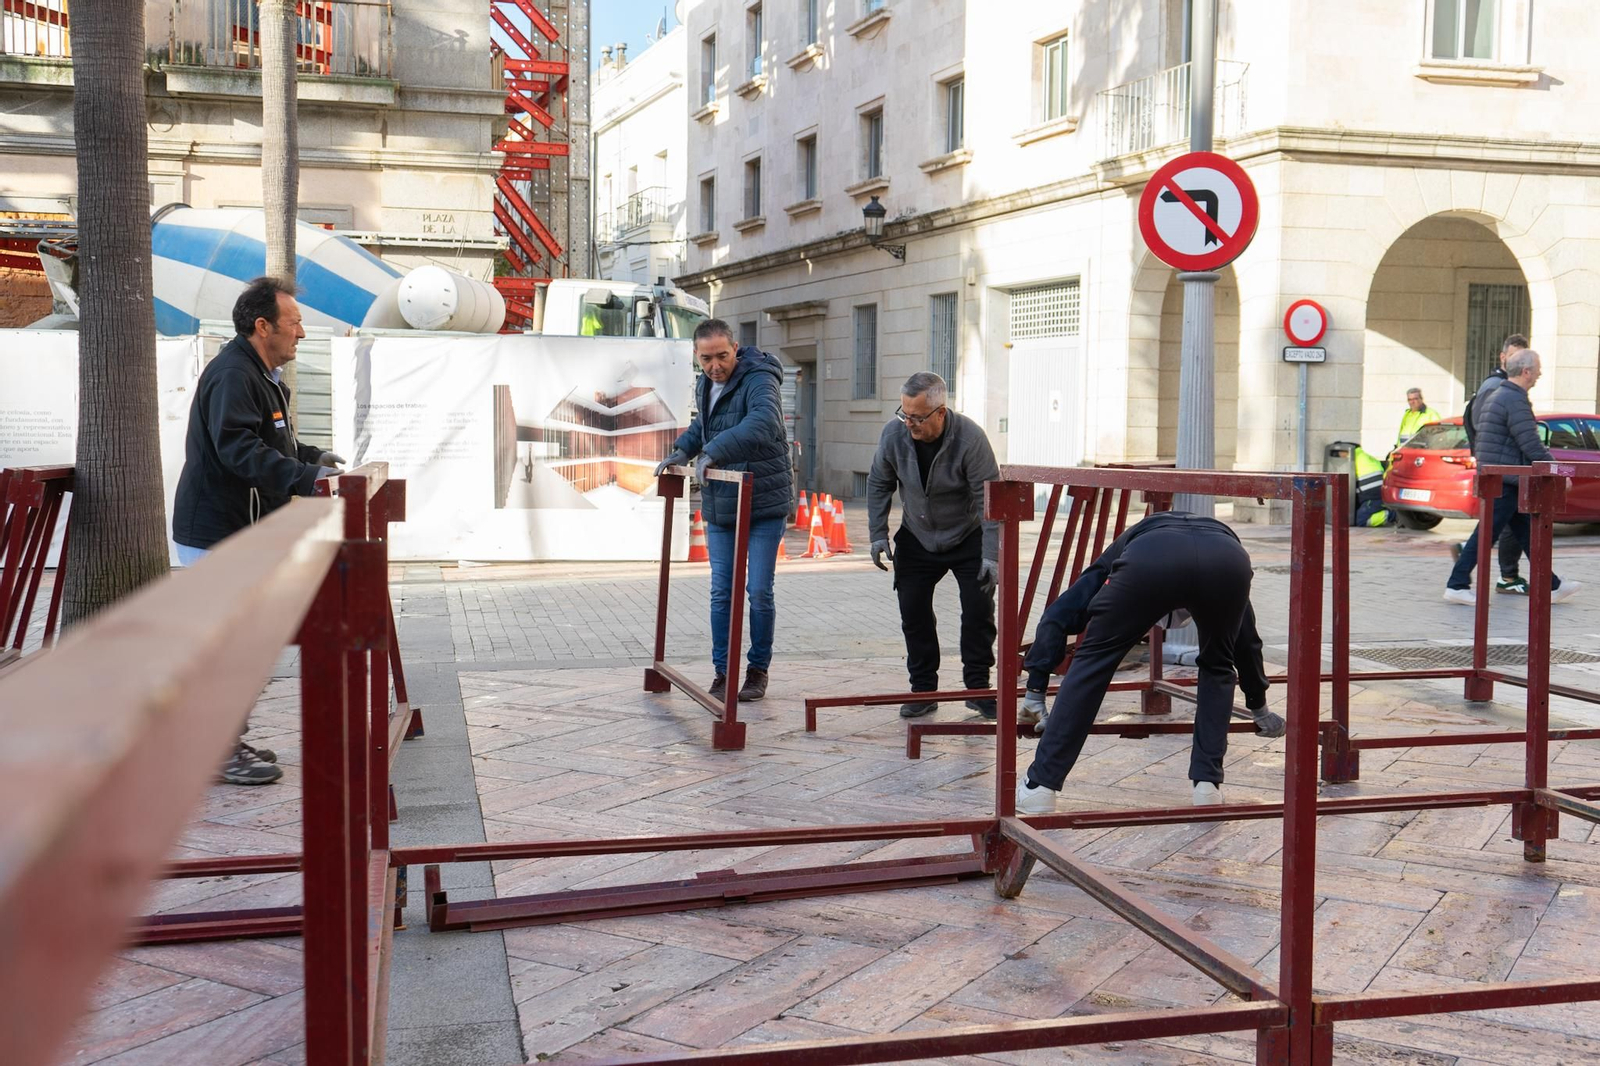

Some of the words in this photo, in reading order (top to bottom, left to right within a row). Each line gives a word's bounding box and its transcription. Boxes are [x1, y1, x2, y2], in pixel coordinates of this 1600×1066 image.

[422, 213, 455, 223] PLAZA
[422, 224, 437, 234] DE
[442, 224, 456, 234] LA
